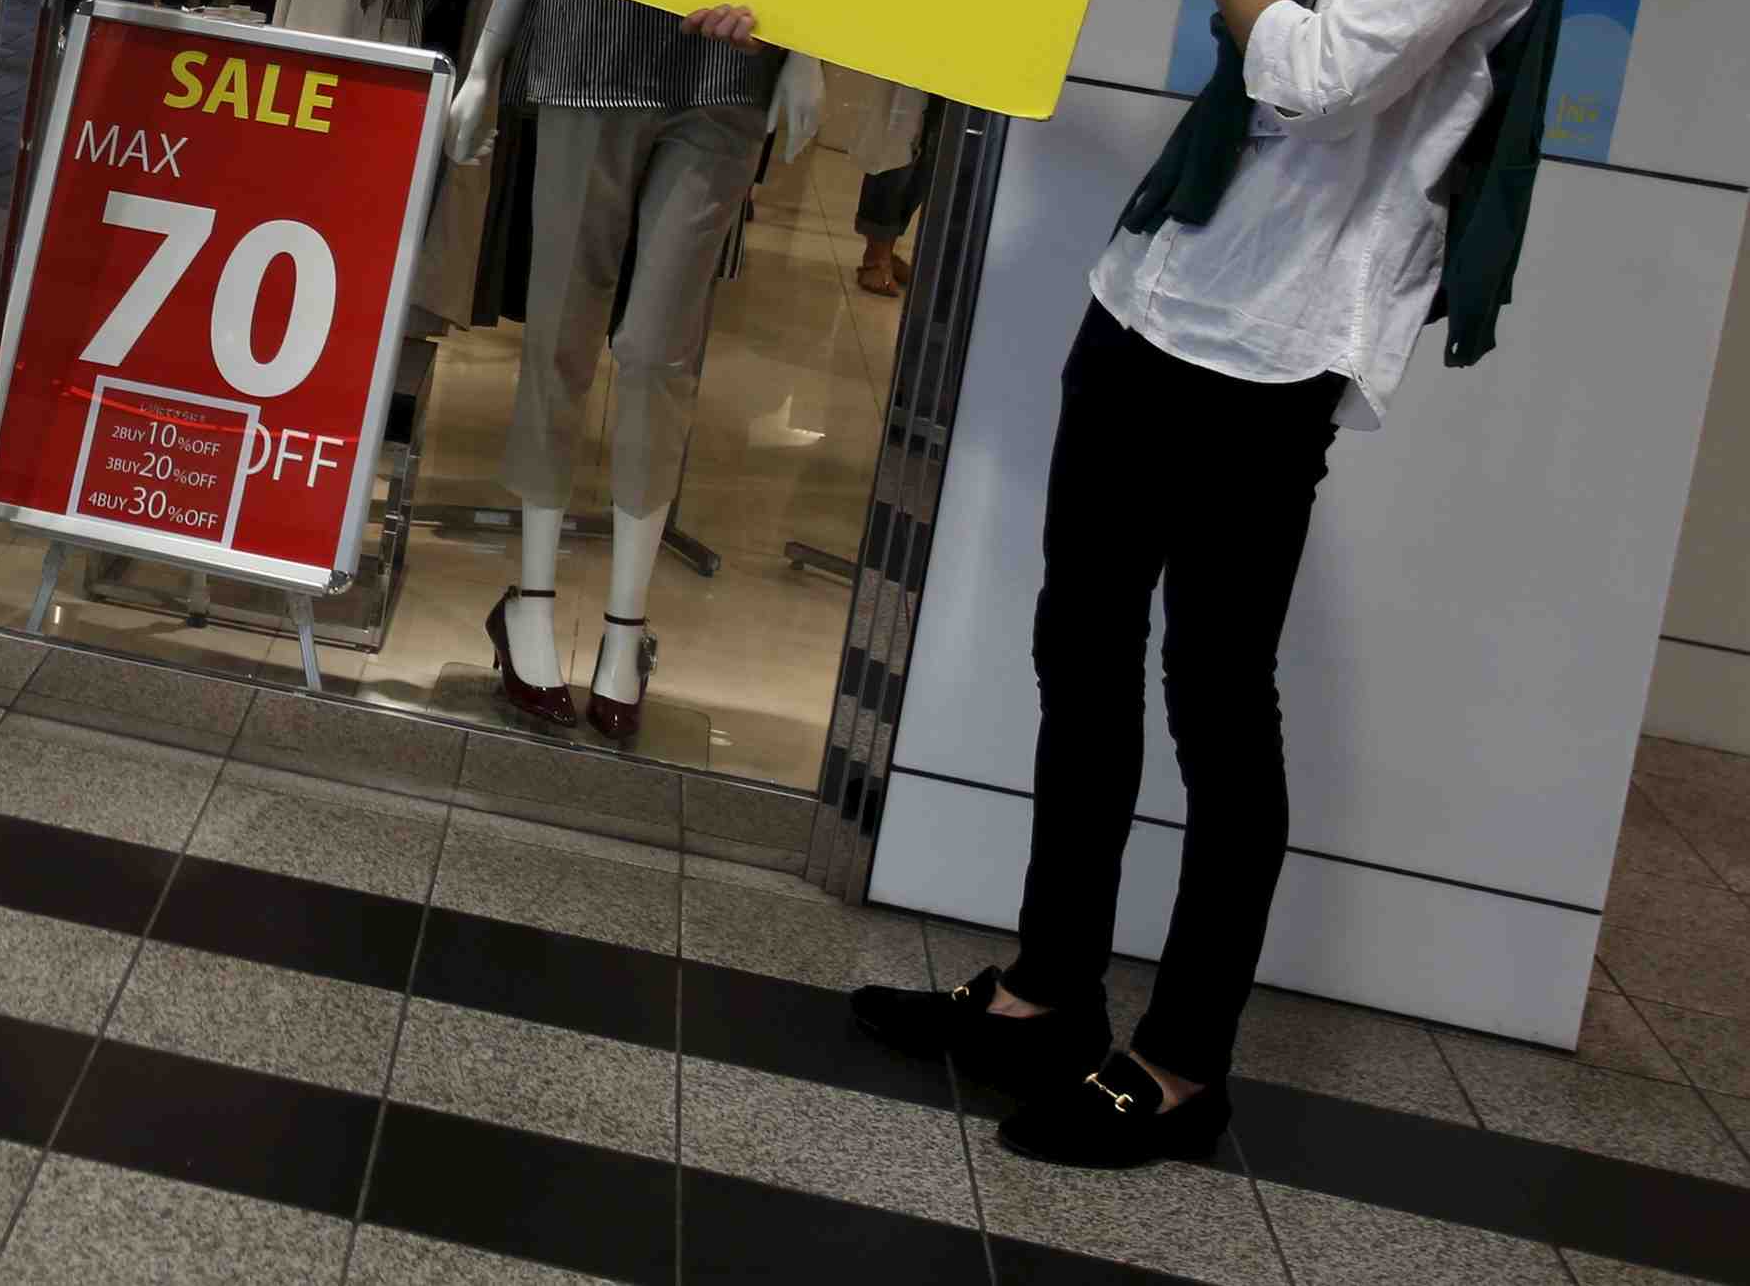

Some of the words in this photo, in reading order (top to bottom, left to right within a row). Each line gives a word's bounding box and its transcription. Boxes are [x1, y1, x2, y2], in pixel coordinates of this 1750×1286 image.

[163, 50, 339, 134] SALE
[74, 119, 189, 178] MAX
[78, 190, 338, 399] 70
[247, 421, 345, 488] OFF
